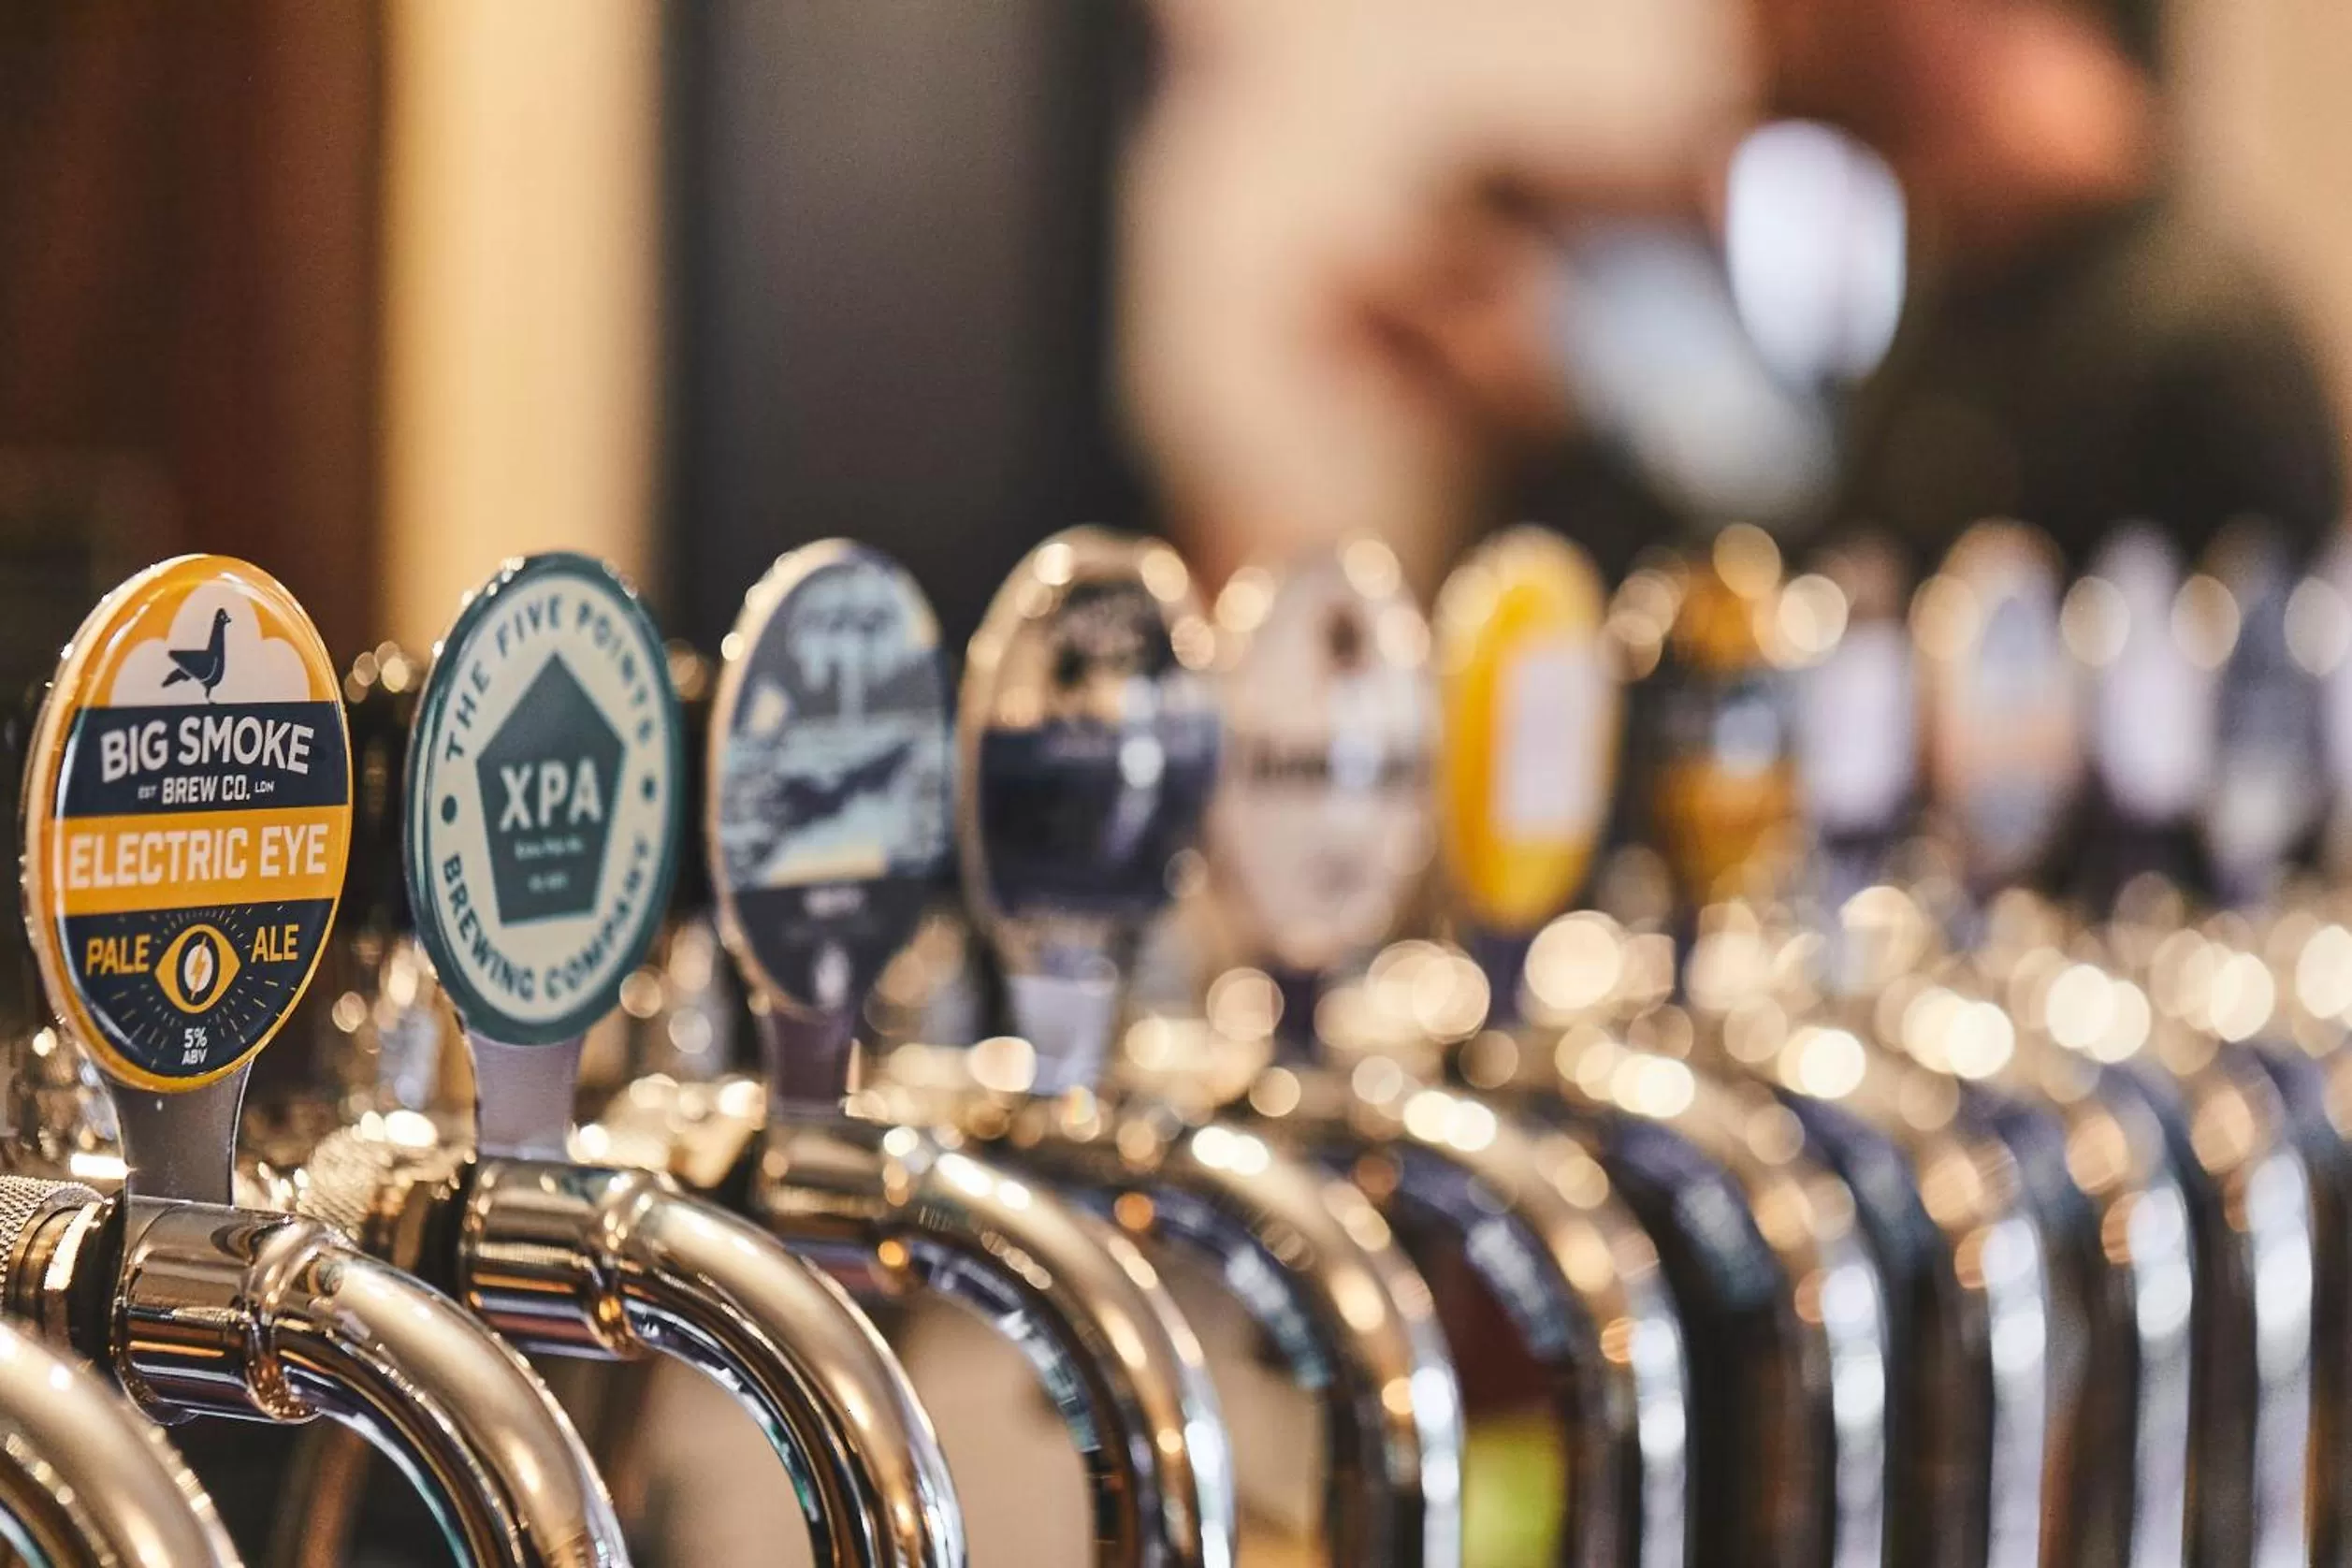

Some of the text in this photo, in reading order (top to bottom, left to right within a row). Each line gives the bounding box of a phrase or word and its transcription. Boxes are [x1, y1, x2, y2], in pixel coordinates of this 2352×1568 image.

[445, 660, 490, 762] THE
[496, 594, 561, 659] FIVE
[100, 715, 314, 783] BIG SMOKE
[162, 776, 218, 805] BREW
[222, 775, 251, 801] CO.
[254, 780, 275, 793] LDN
[499, 757, 603, 832] XPA
[69, 823, 328, 890] ELECTRIC EYE
[86, 924, 299, 975] PALE ALE
[443, 852, 534, 1001] BREWING
[181, 1048, 208, 1065] ABV
[184, 1026, 208, 1048] 5%
